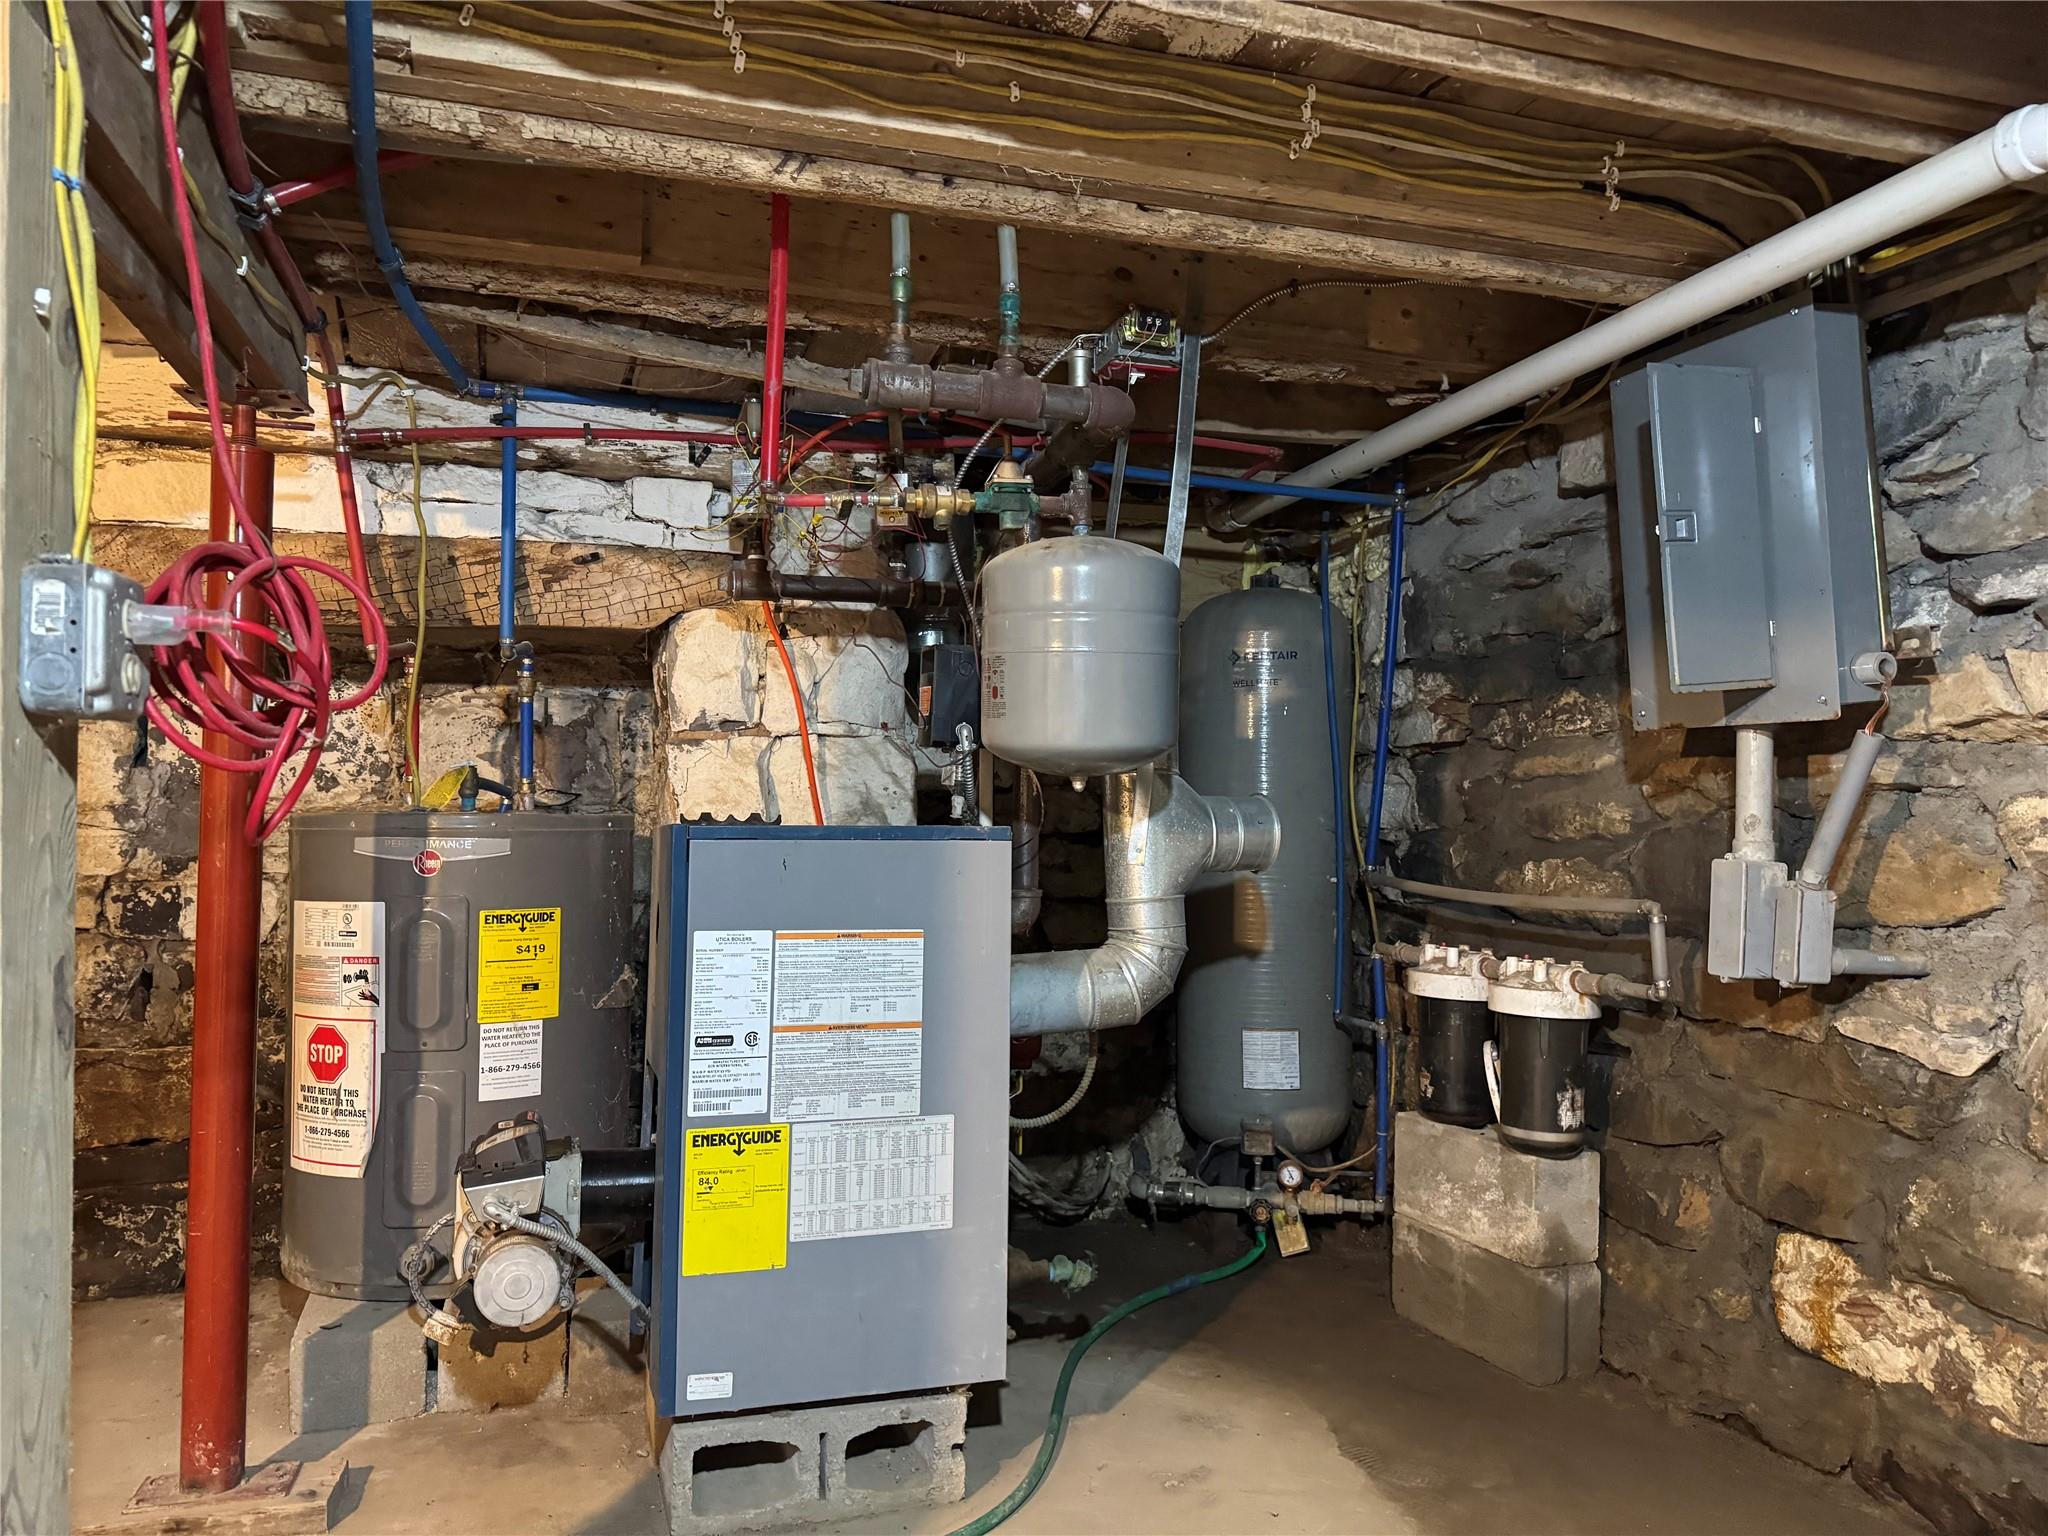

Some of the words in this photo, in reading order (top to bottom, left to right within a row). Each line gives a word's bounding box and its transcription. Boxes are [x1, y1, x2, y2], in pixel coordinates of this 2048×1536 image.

[484, 911, 556, 925] ENERGYGUIDE
[516, 943, 546, 955] $419
[310, 1043, 344, 1065] STOP
[480, 1061, 541, 1074] 1-866-279-4566
[300, 1084, 306, 1092] DO
[307, 1085, 316, 1094] NOT
[318, 1086, 341, 1097] RETUR
[344, 1088, 359, 1098] THIS
[302, 1094, 319, 1104] WATER
[320, 1096, 343, 1107] HEATR
[346, 1098, 354, 1107] TO
[304, 1104, 320, 1114] PLACE
[322, 1106, 329, 1116] OF
[304, 1125, 350, 1139] 1-866-279-4566
[692, 1130, 782, 1148] ENERGYGUIDE
[698, 1176, 719, 1186] 84.0
